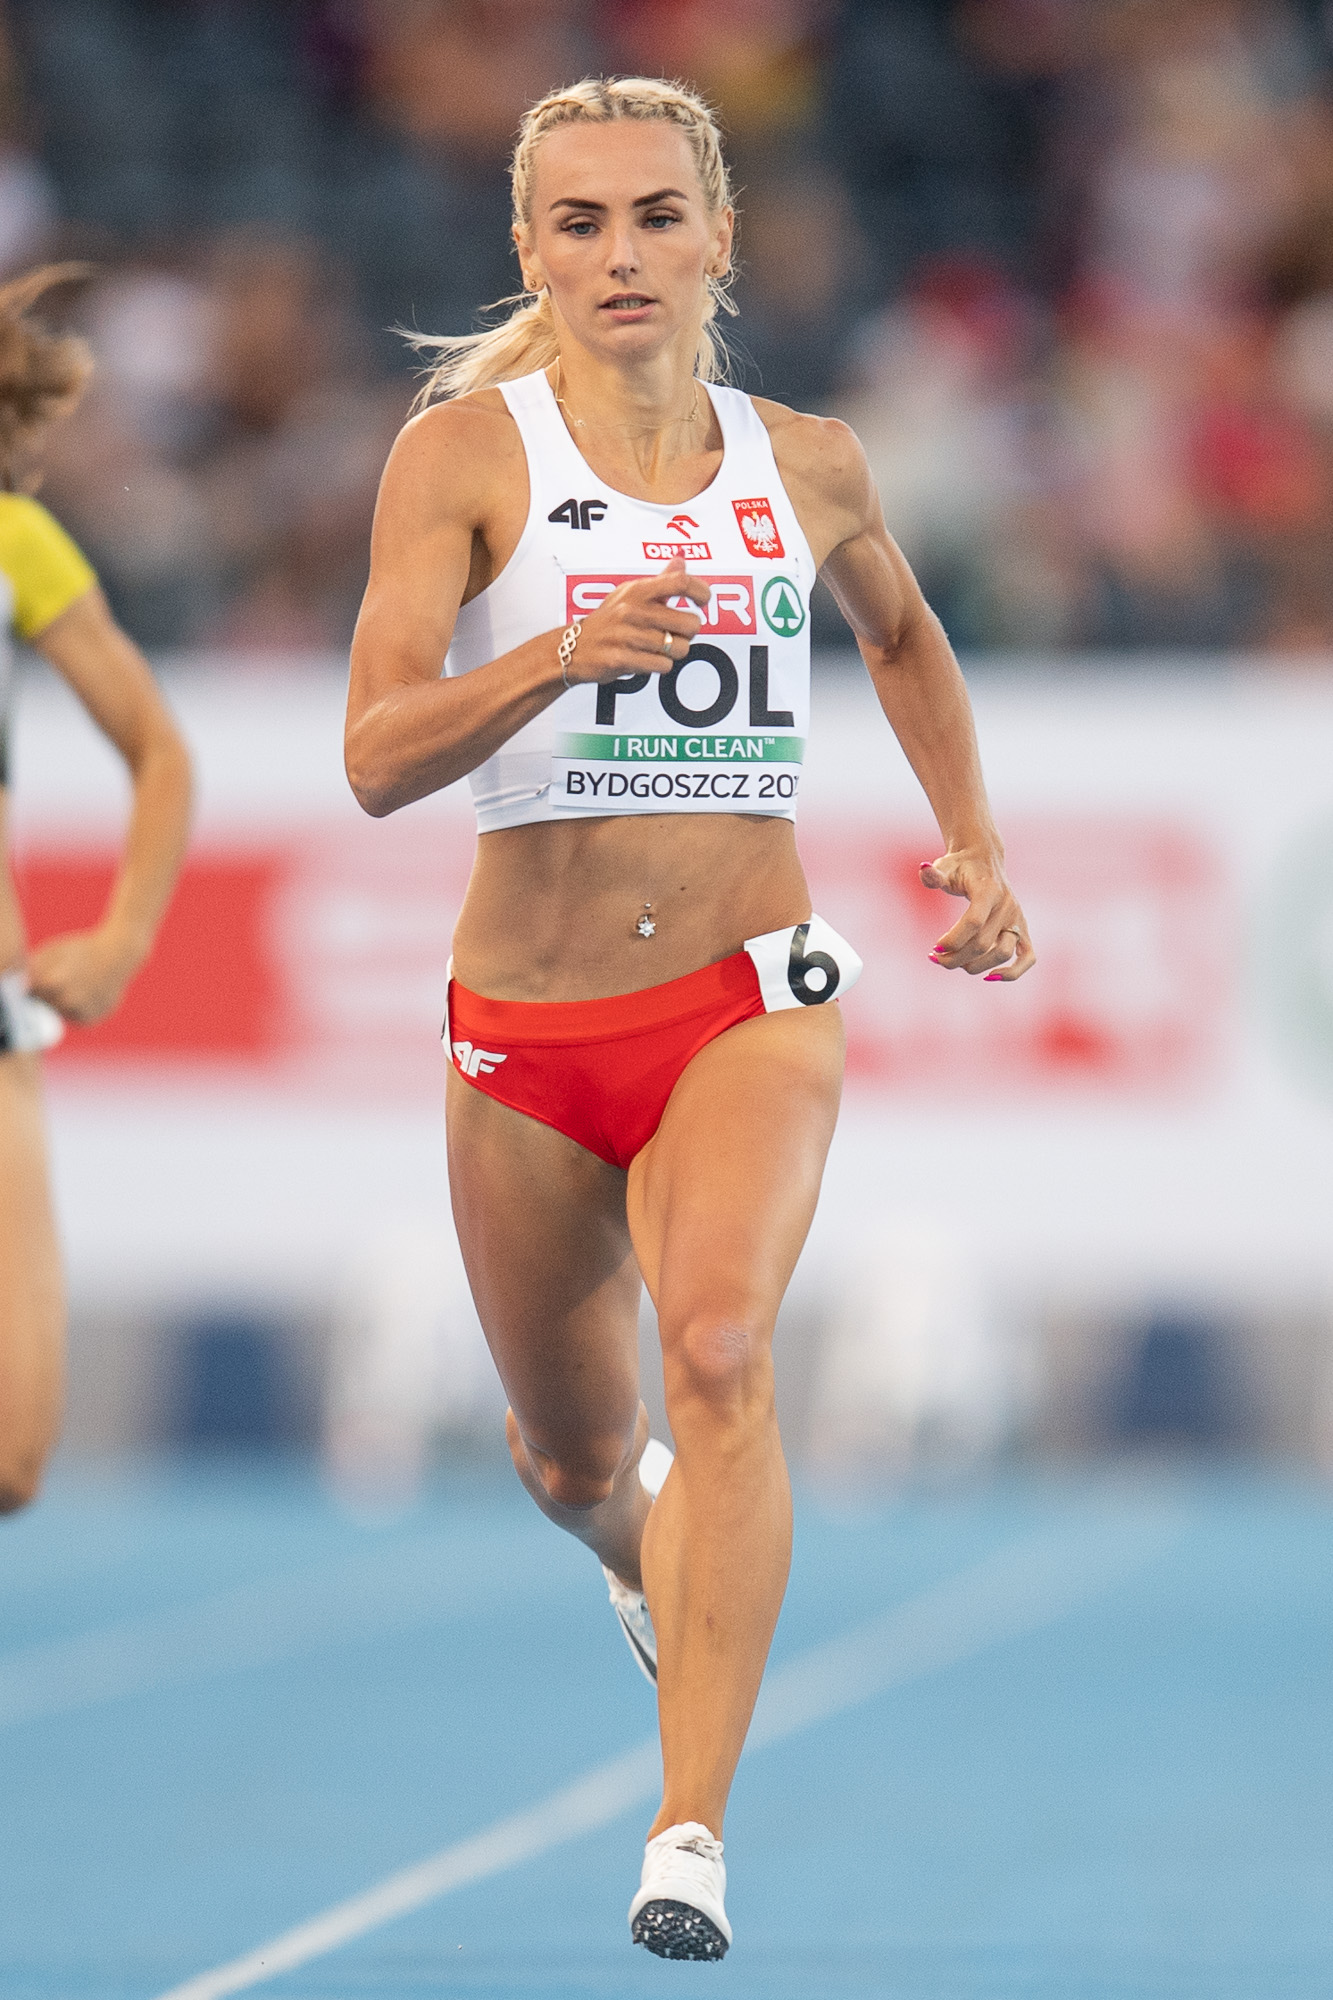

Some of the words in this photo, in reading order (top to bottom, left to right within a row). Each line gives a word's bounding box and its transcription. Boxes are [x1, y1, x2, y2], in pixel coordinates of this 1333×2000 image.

[735, 500, 769, 510] POLSKA
[613, 738, 620, 757] I
[627, 738, 678, 758] RUN
[566, 770, 750, 798] BYDGOSZCZ
[758, 773, 799, 798] 20
[787, 923, 840, 1007] 6
